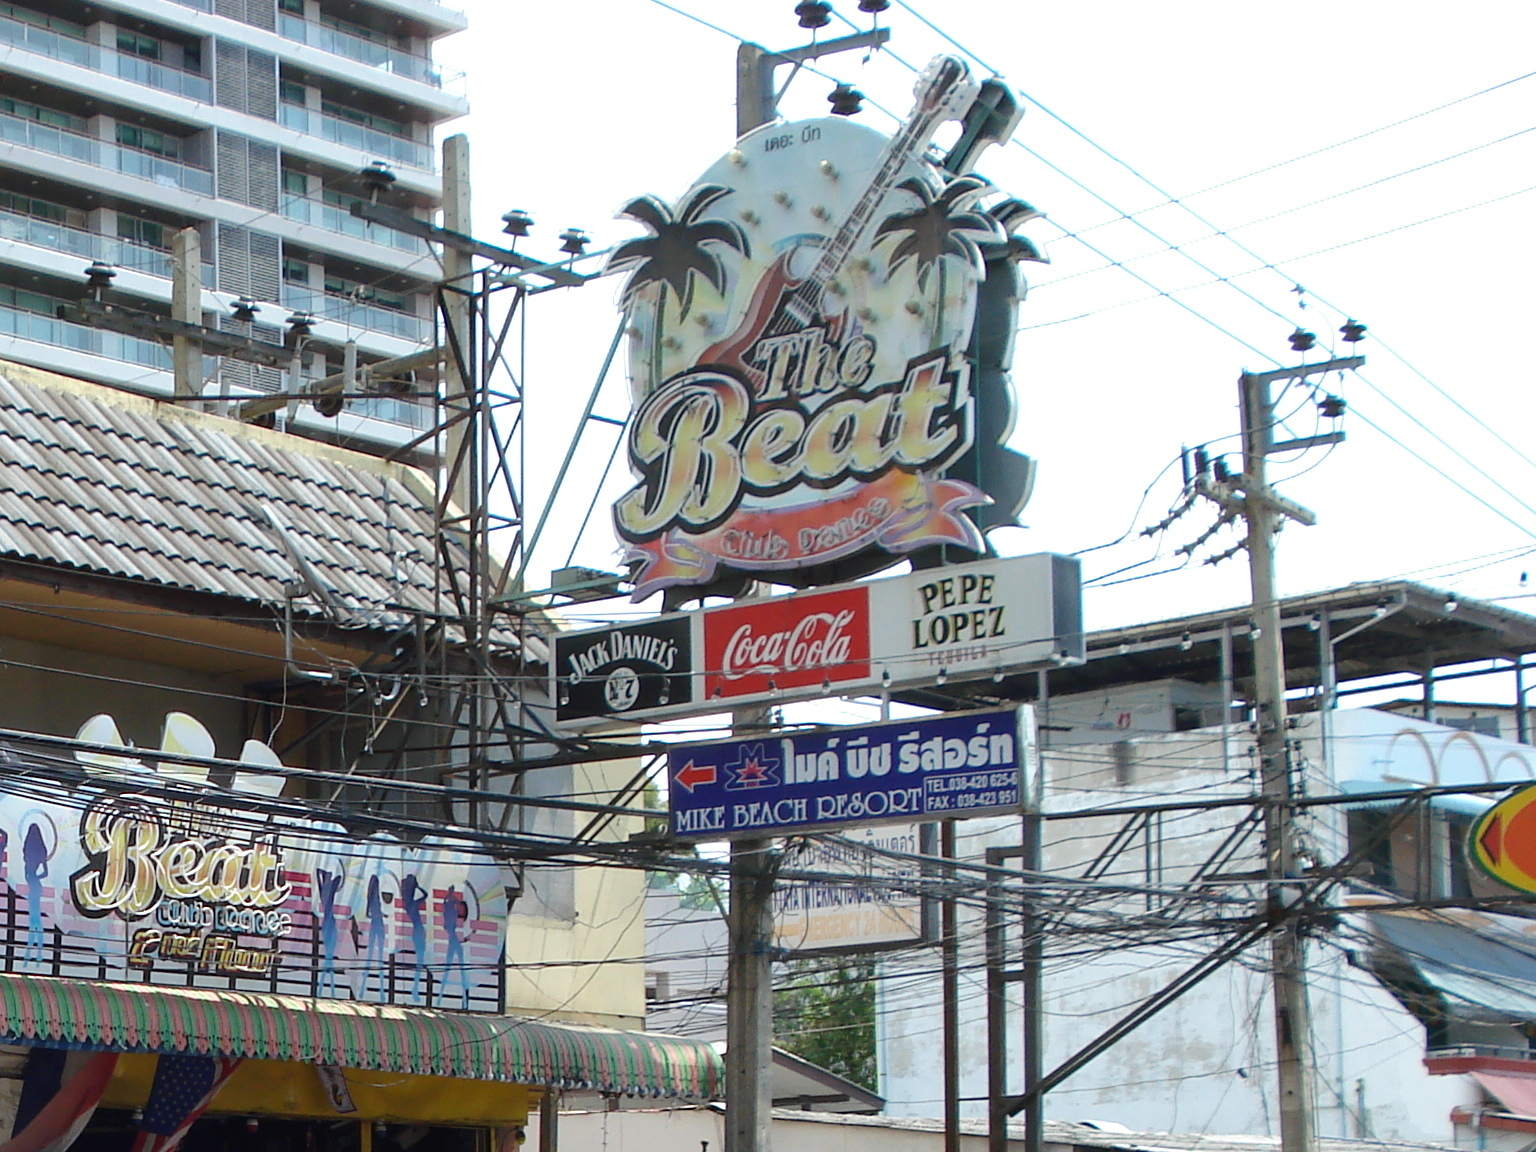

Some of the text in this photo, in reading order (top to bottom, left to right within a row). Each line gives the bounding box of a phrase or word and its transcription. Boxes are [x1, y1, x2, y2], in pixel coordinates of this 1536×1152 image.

[755, 328, 875, 401] The
[615, 352, 969, 541] Beat
[720, 500, 891, 560] Club Dance
[917, 574, 995, 616] PEPE
[722, 609, 856, 680] Coca-Cola
[911, 605, 1006, 650] LOPEZ
[928, 644, 988, 666] TEQUILA
[568, 630, 679, 685] JACK DANIEL'S
[781, 722, 1014, 786] ไมค์ บีช รีสอร์ท
[675, 787, 922, 833] MIKE BEACH RESORT
[927, 796, 950, 810] FAX
[72, 797, 292, 917] Beat
